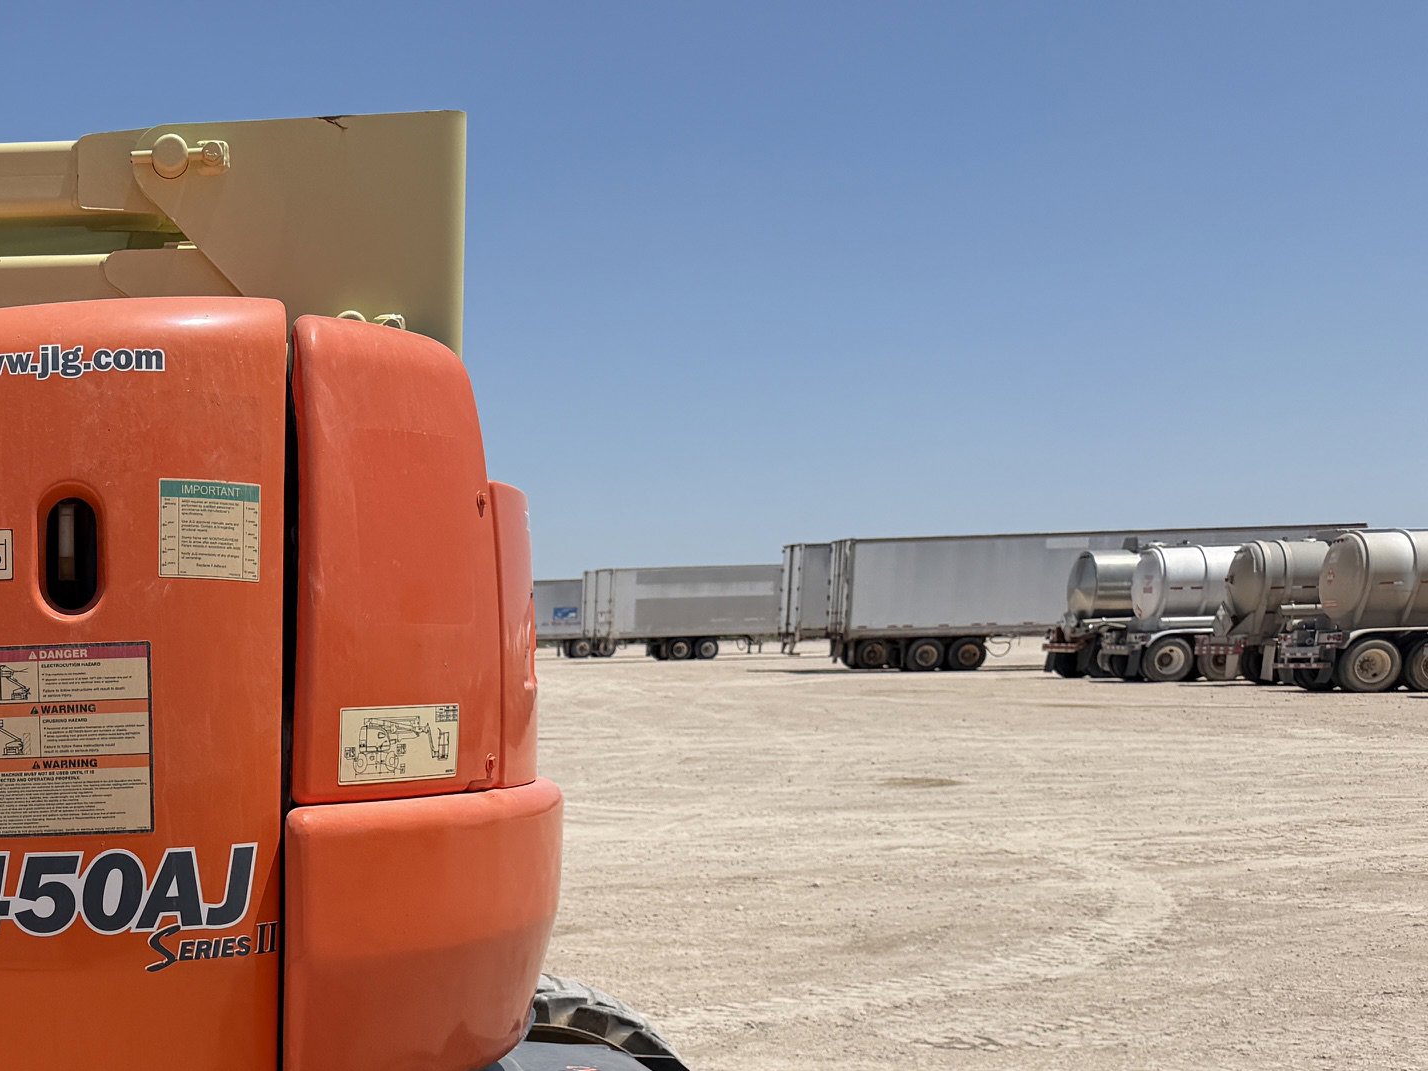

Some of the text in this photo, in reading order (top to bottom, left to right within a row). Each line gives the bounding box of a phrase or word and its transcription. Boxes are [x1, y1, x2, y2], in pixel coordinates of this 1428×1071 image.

[181, 485, 241, 497] IMPORTANT
[39, 649, 88, 660] DANGER
[41, 704, 97, 714] WARNING
[43, 759, 98, 769] WARNING
[145, 922, 252, 972] SERIES
